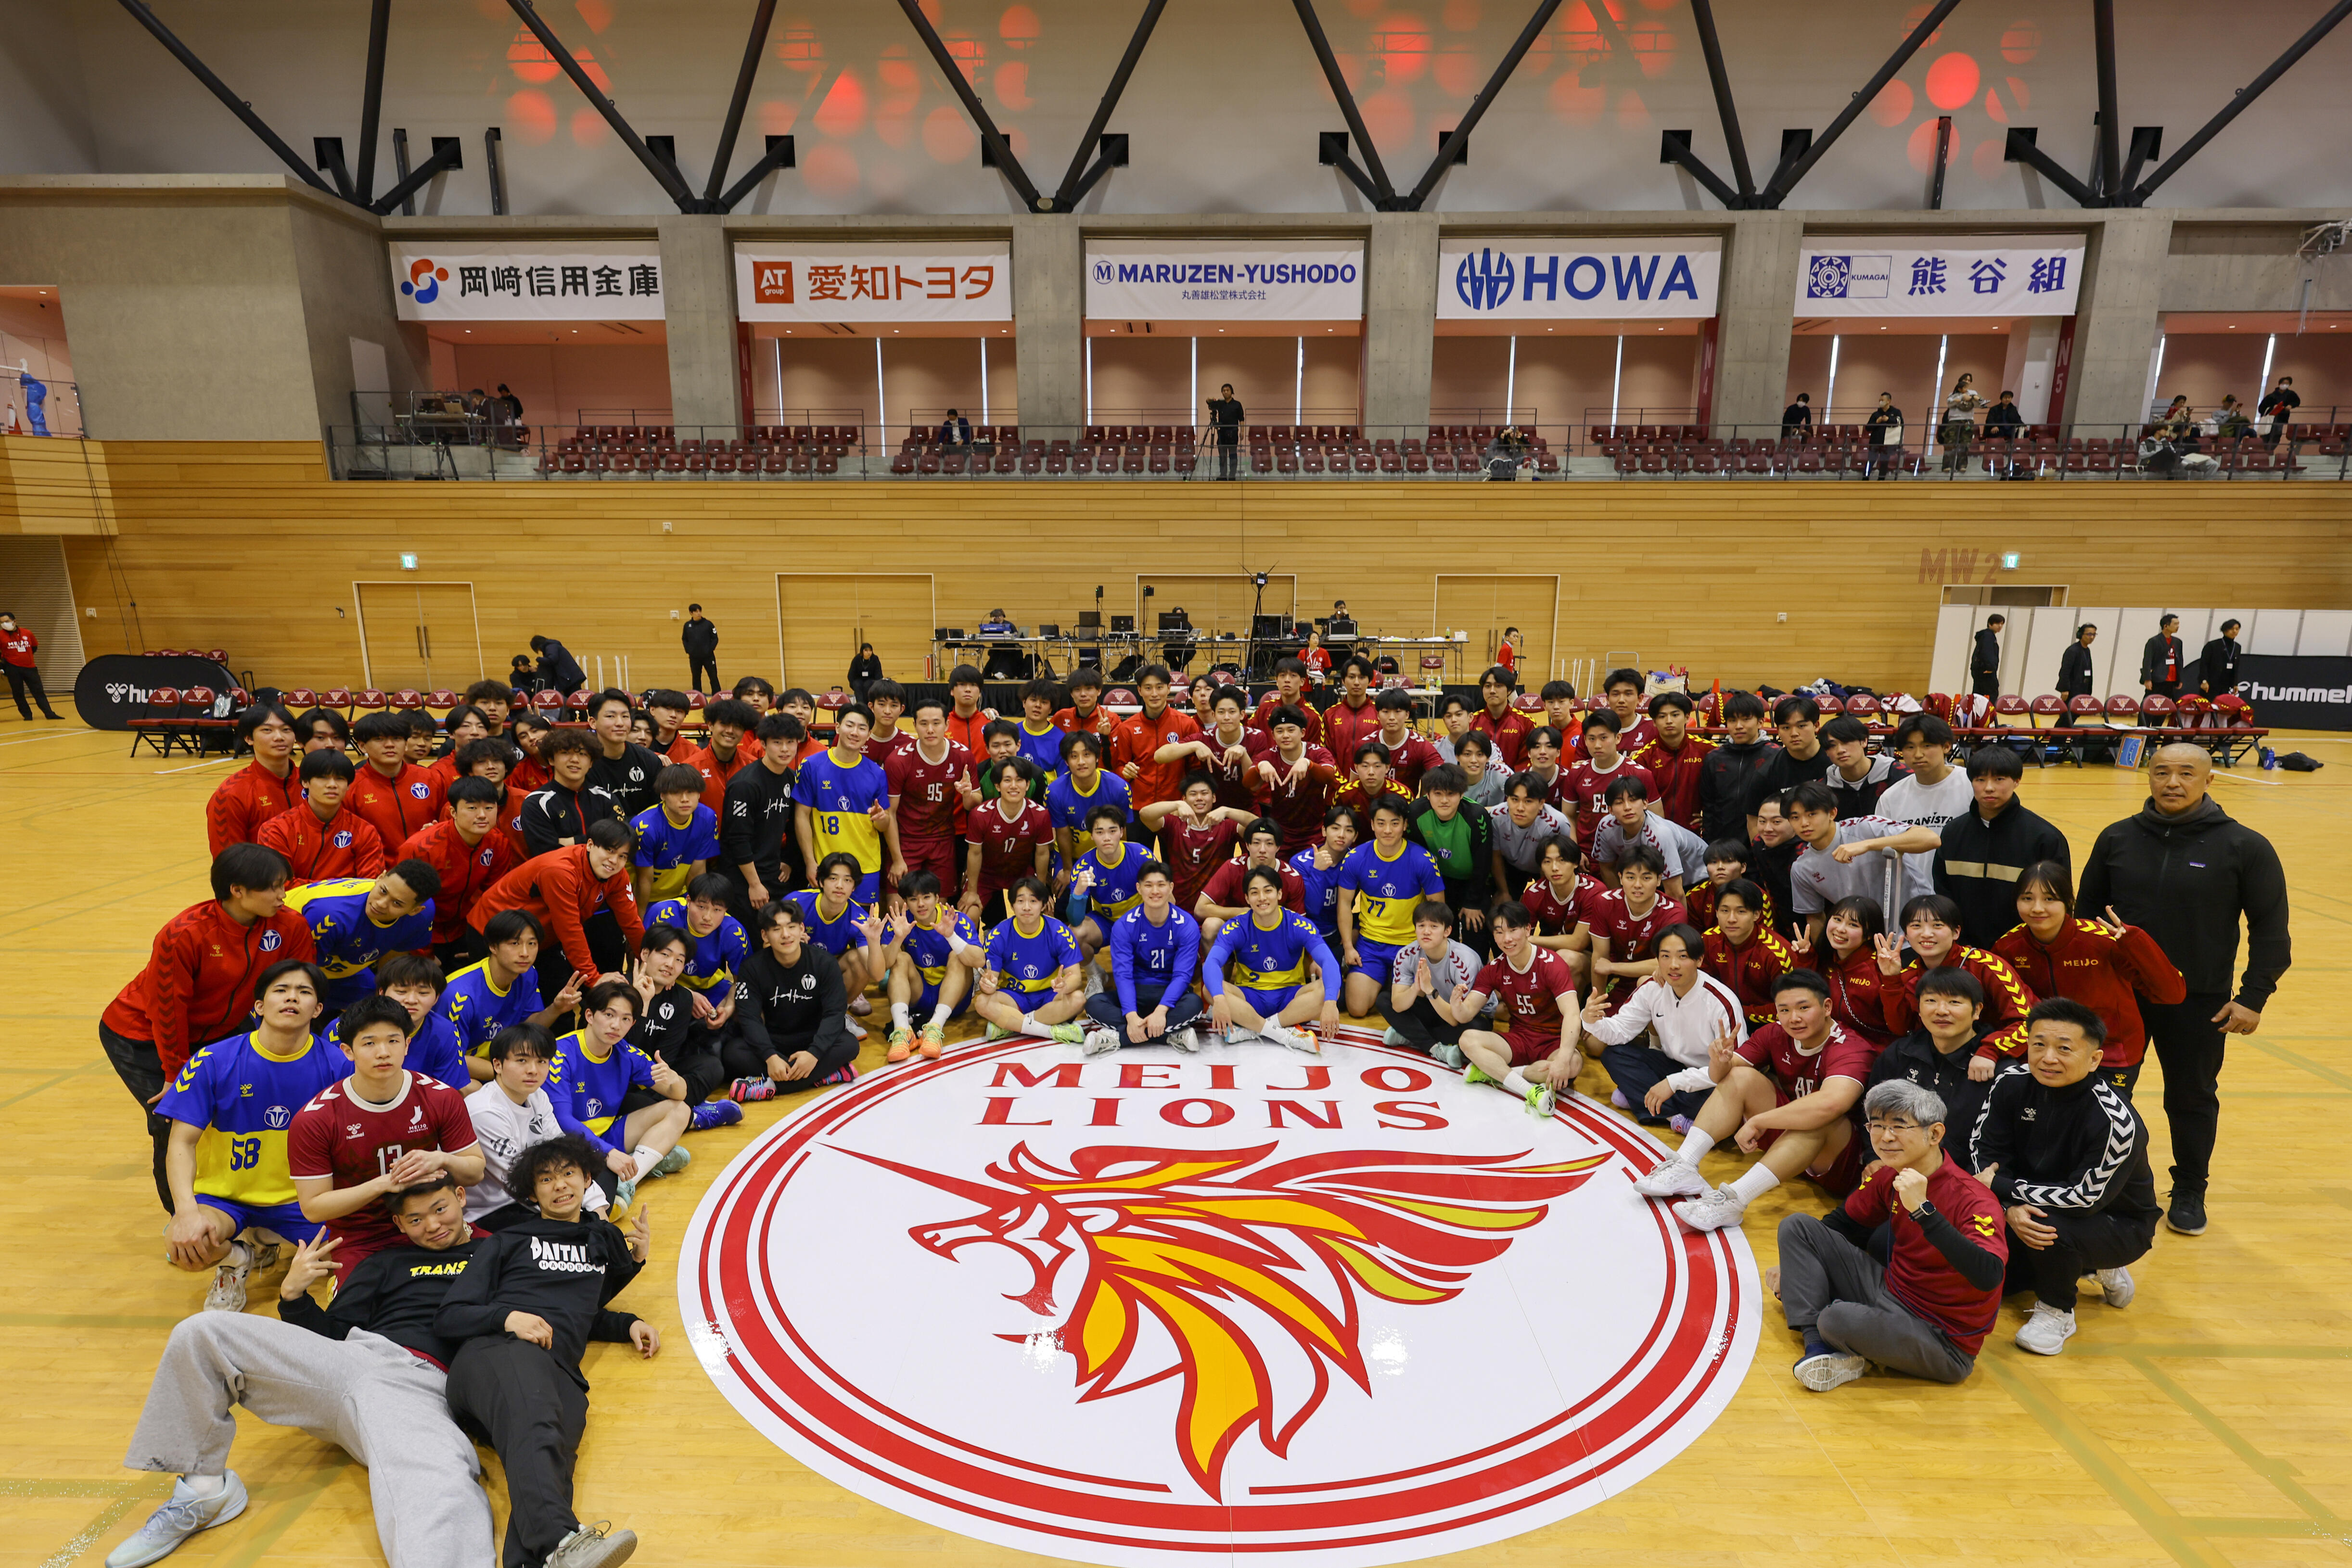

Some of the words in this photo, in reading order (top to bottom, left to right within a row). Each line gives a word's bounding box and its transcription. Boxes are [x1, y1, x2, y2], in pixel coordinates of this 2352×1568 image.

[760, 269, 786, 290] AT
[807, 265, 994, 301] 愛知トヨタ
[1118, 264, 1356, 284] MARUZEN-YUSHODO
[1523, 255, 1699, 301] HOWA
[1908, 256, 2067, 296] 熊谷組
[1182, 290, 1266, 300] 丸善雄松堂株式会社
[2057, 338, 2071, 367] N
[2056, 373, 2064, 394] 5
[1918, 548, 1979, 585] MW
[1983, 554, 2001, 585] 2
[2251, 682, 2352, 704] hummel
[1224, 766, 1238, 781] 24
[927, 783, 943, 802] 95
[820, 816, 840, 835] 18
[1004, 838, 1016, 853] 17
[1192, 848, 1201, 864] 5
[1367, 898, 1385, 917] 77
[1151, 949, 1165, 969] 21
[1850, 977, 1871, 986] MEIJO
[1516, 994, 1536, 1015] 55
[984, 1062, 1436, 1092] MEIJO
[972, 1097, 1449, 1131] LIONS
[346, 1132, 365, 1140] hummel
[229, 1138, 262, 1172] 58
[377, 1145, 402, 1177] 13
[409, 1260, 469, 1277] TRANS
[538, 1261, 606, 1275] HANDBA
